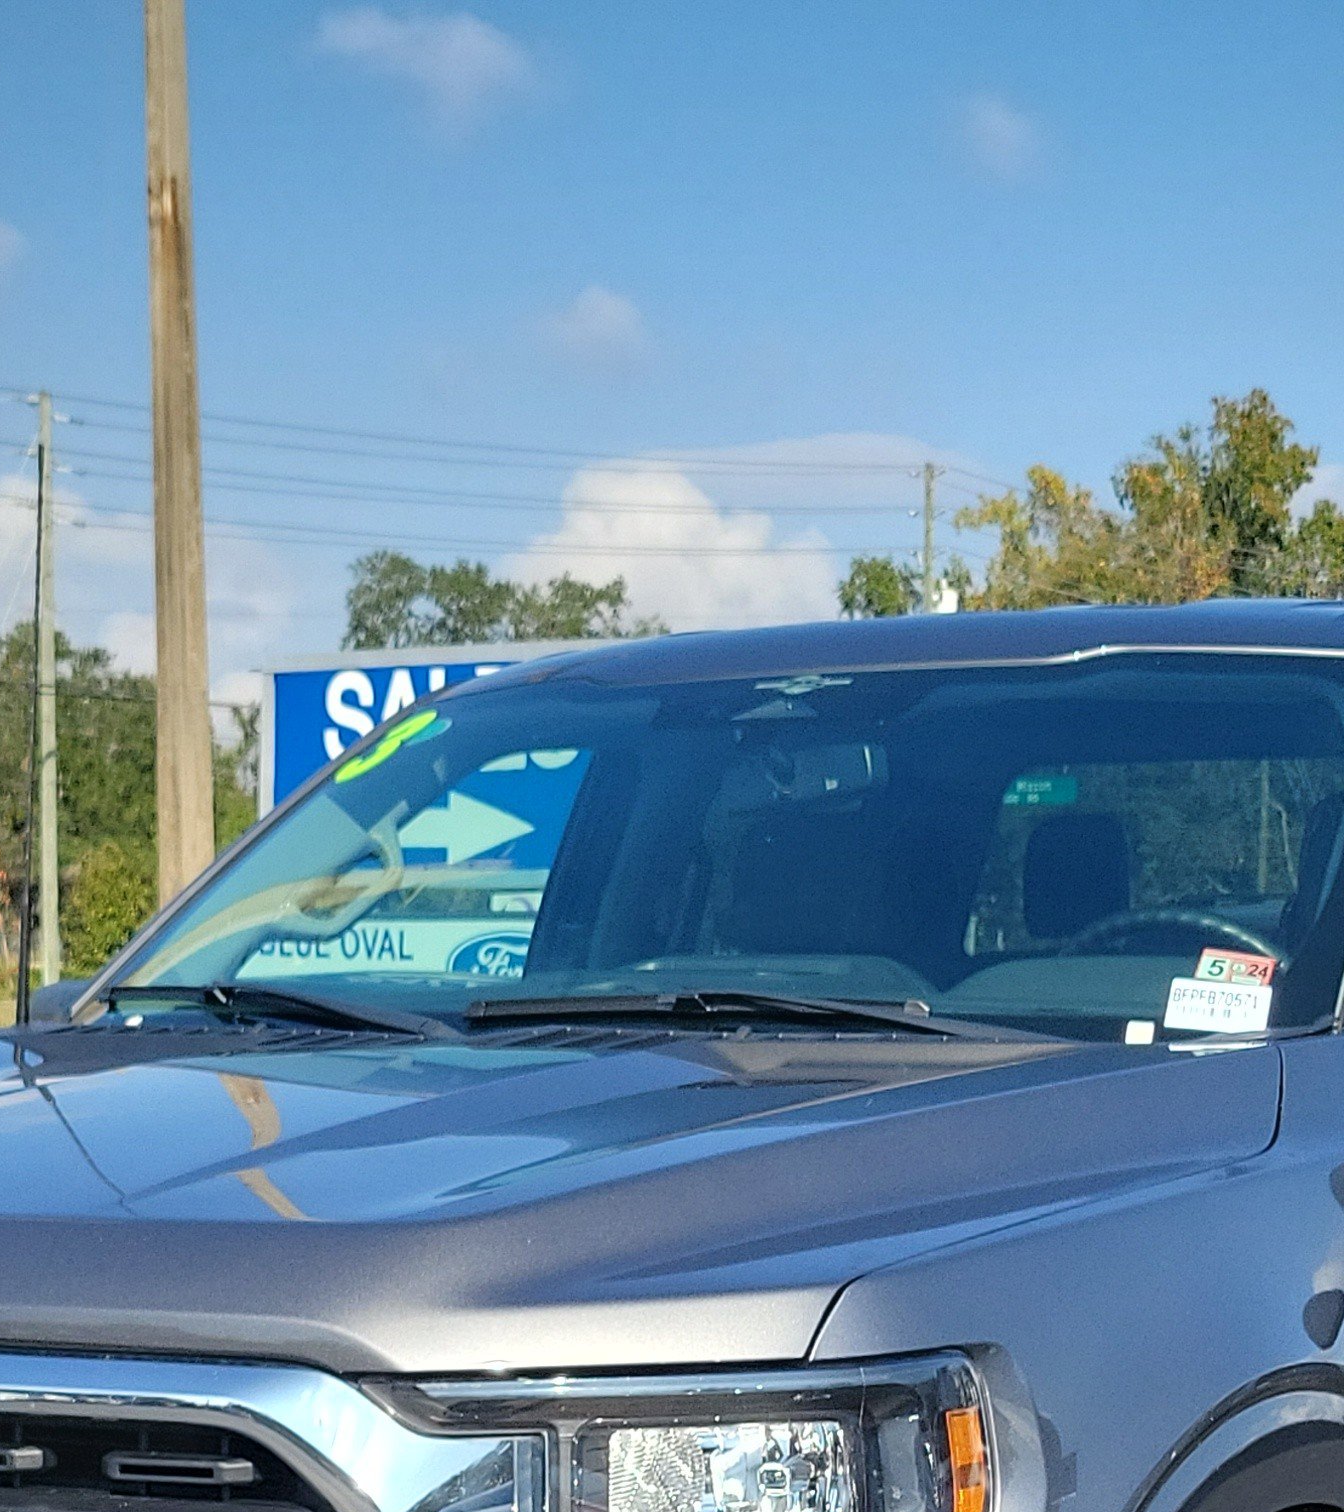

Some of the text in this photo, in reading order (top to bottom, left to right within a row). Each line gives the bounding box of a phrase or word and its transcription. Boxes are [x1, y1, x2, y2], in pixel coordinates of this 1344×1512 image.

[340, 928, 414, 961] OVAL
[1207, 959, 1269, 979] 5 24
